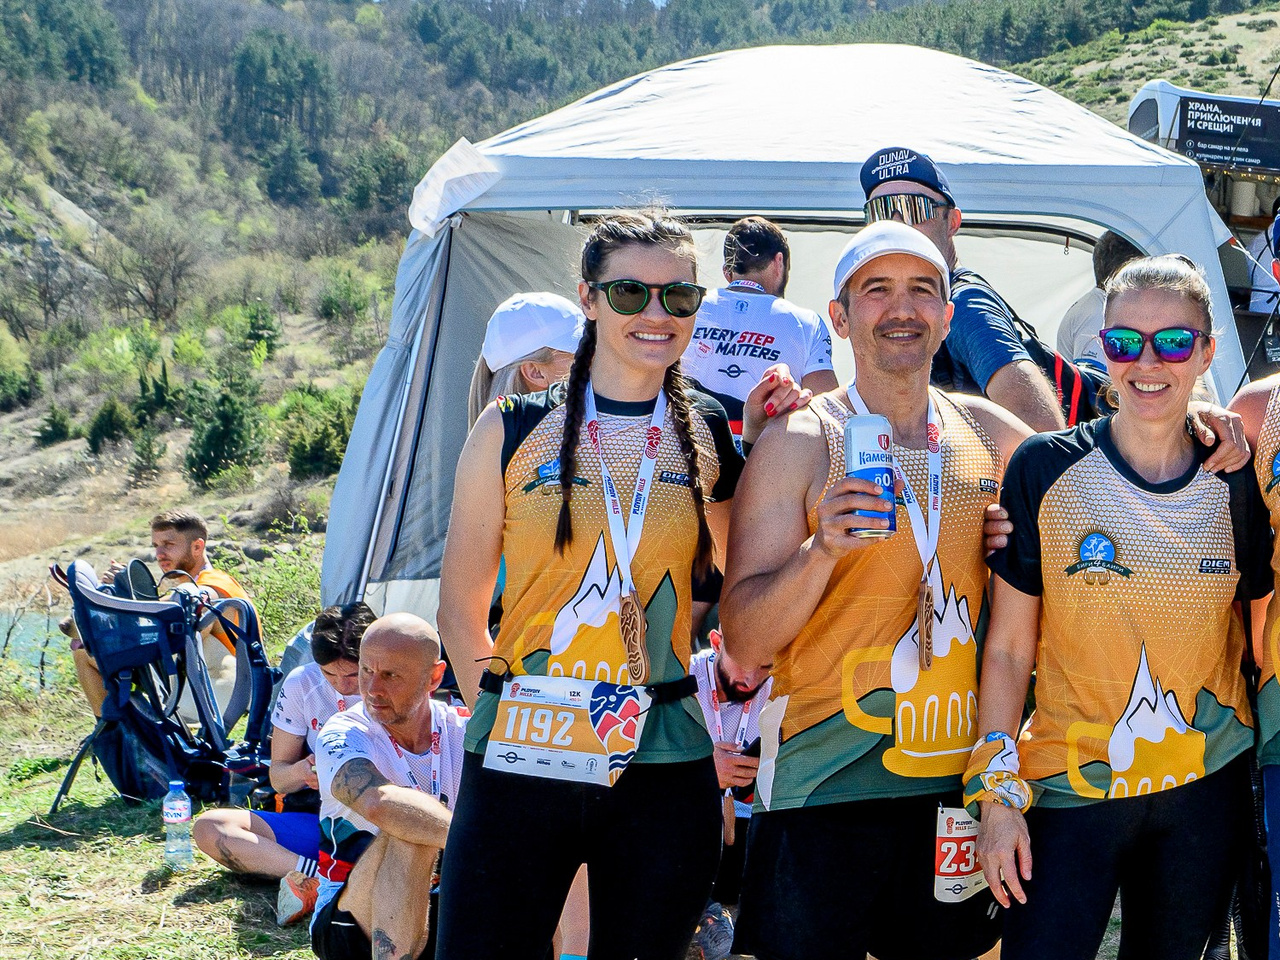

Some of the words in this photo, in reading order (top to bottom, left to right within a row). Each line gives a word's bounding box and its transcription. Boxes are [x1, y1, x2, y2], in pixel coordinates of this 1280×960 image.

[1188, 101, 1222, 114] ХРАНА,
[1187, 111, 1262, 127] ПРИКЛЮЧЕНИЯ
[1187, 120, 1195, 128] И
[1196, 121, 1233, 133] СРЕЩИ!
[879, 149, 910, 166] DUNAV
[879, 164, 909, 180] ULTRA
[692, 327, 739, 342] EVERY
[737, 331, 775, 346] STEP
[715, 342, 781, 361] MATTERS
[1202, 560, 1230, 568] DIEM
[504, 706, 576, 747] 1192
[940, 840, 978, 873] 23
